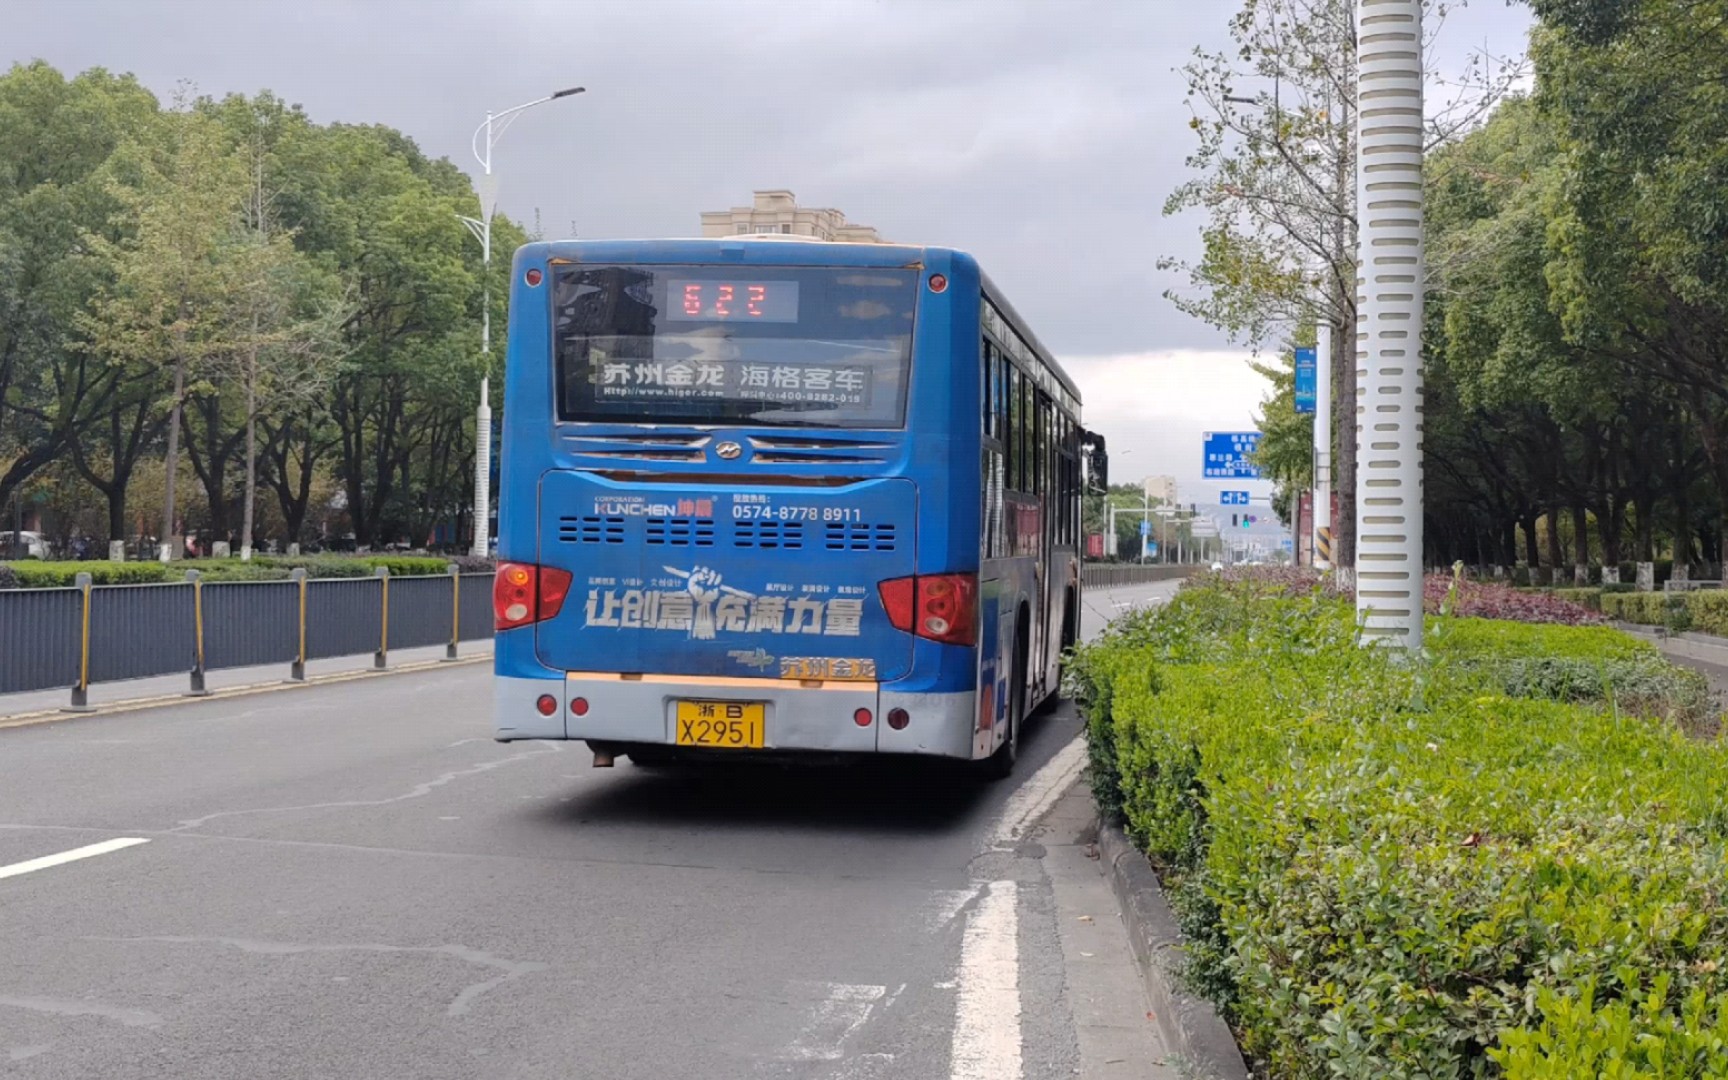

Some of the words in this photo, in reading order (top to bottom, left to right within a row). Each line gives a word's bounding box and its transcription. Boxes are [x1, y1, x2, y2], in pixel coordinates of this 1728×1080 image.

[683, 284, 766, 316] 622
[603, 362, 725, 386] 苏州金龙
[740, 365, 864, 391] 海格客车
[594, 503, 677, 516] KUNCHEN
[732, 505, 818, 520] 0574-8778
[823, 507, 861, 522] 8911
[780, 656, 876, 678] 苏州金龙
[681, 719, 754, 744] X2951
